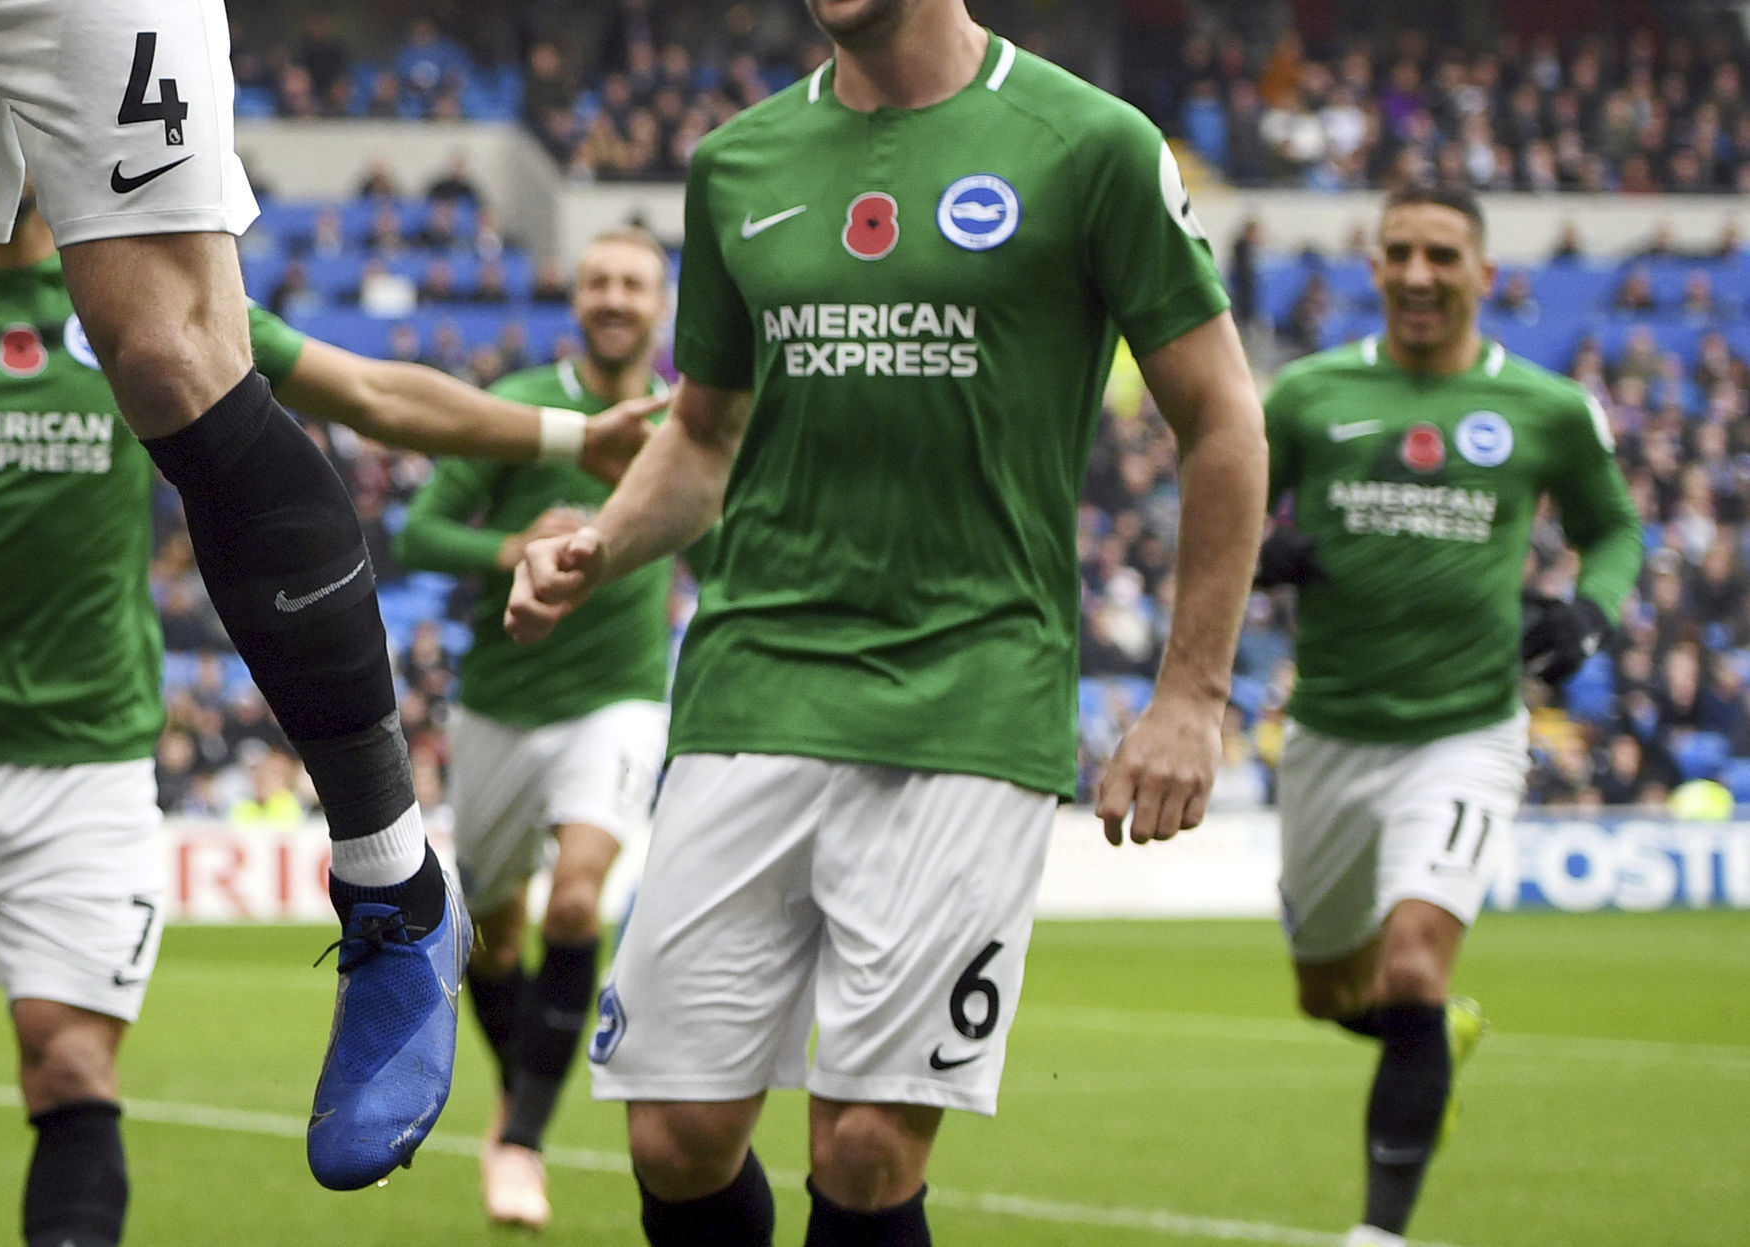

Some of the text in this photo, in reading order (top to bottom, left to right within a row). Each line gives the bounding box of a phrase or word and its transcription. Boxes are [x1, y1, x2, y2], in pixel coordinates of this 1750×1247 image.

[118, 32, 188, 146] 4
[764, 303, 976, 343] AMERICAN
[785, 342, 978, 377] EXPRESS
[1445, 798, 1492, 866] 11
[130, 894, 155, 965] 7
[950, 940, 1004, 1039] 6
